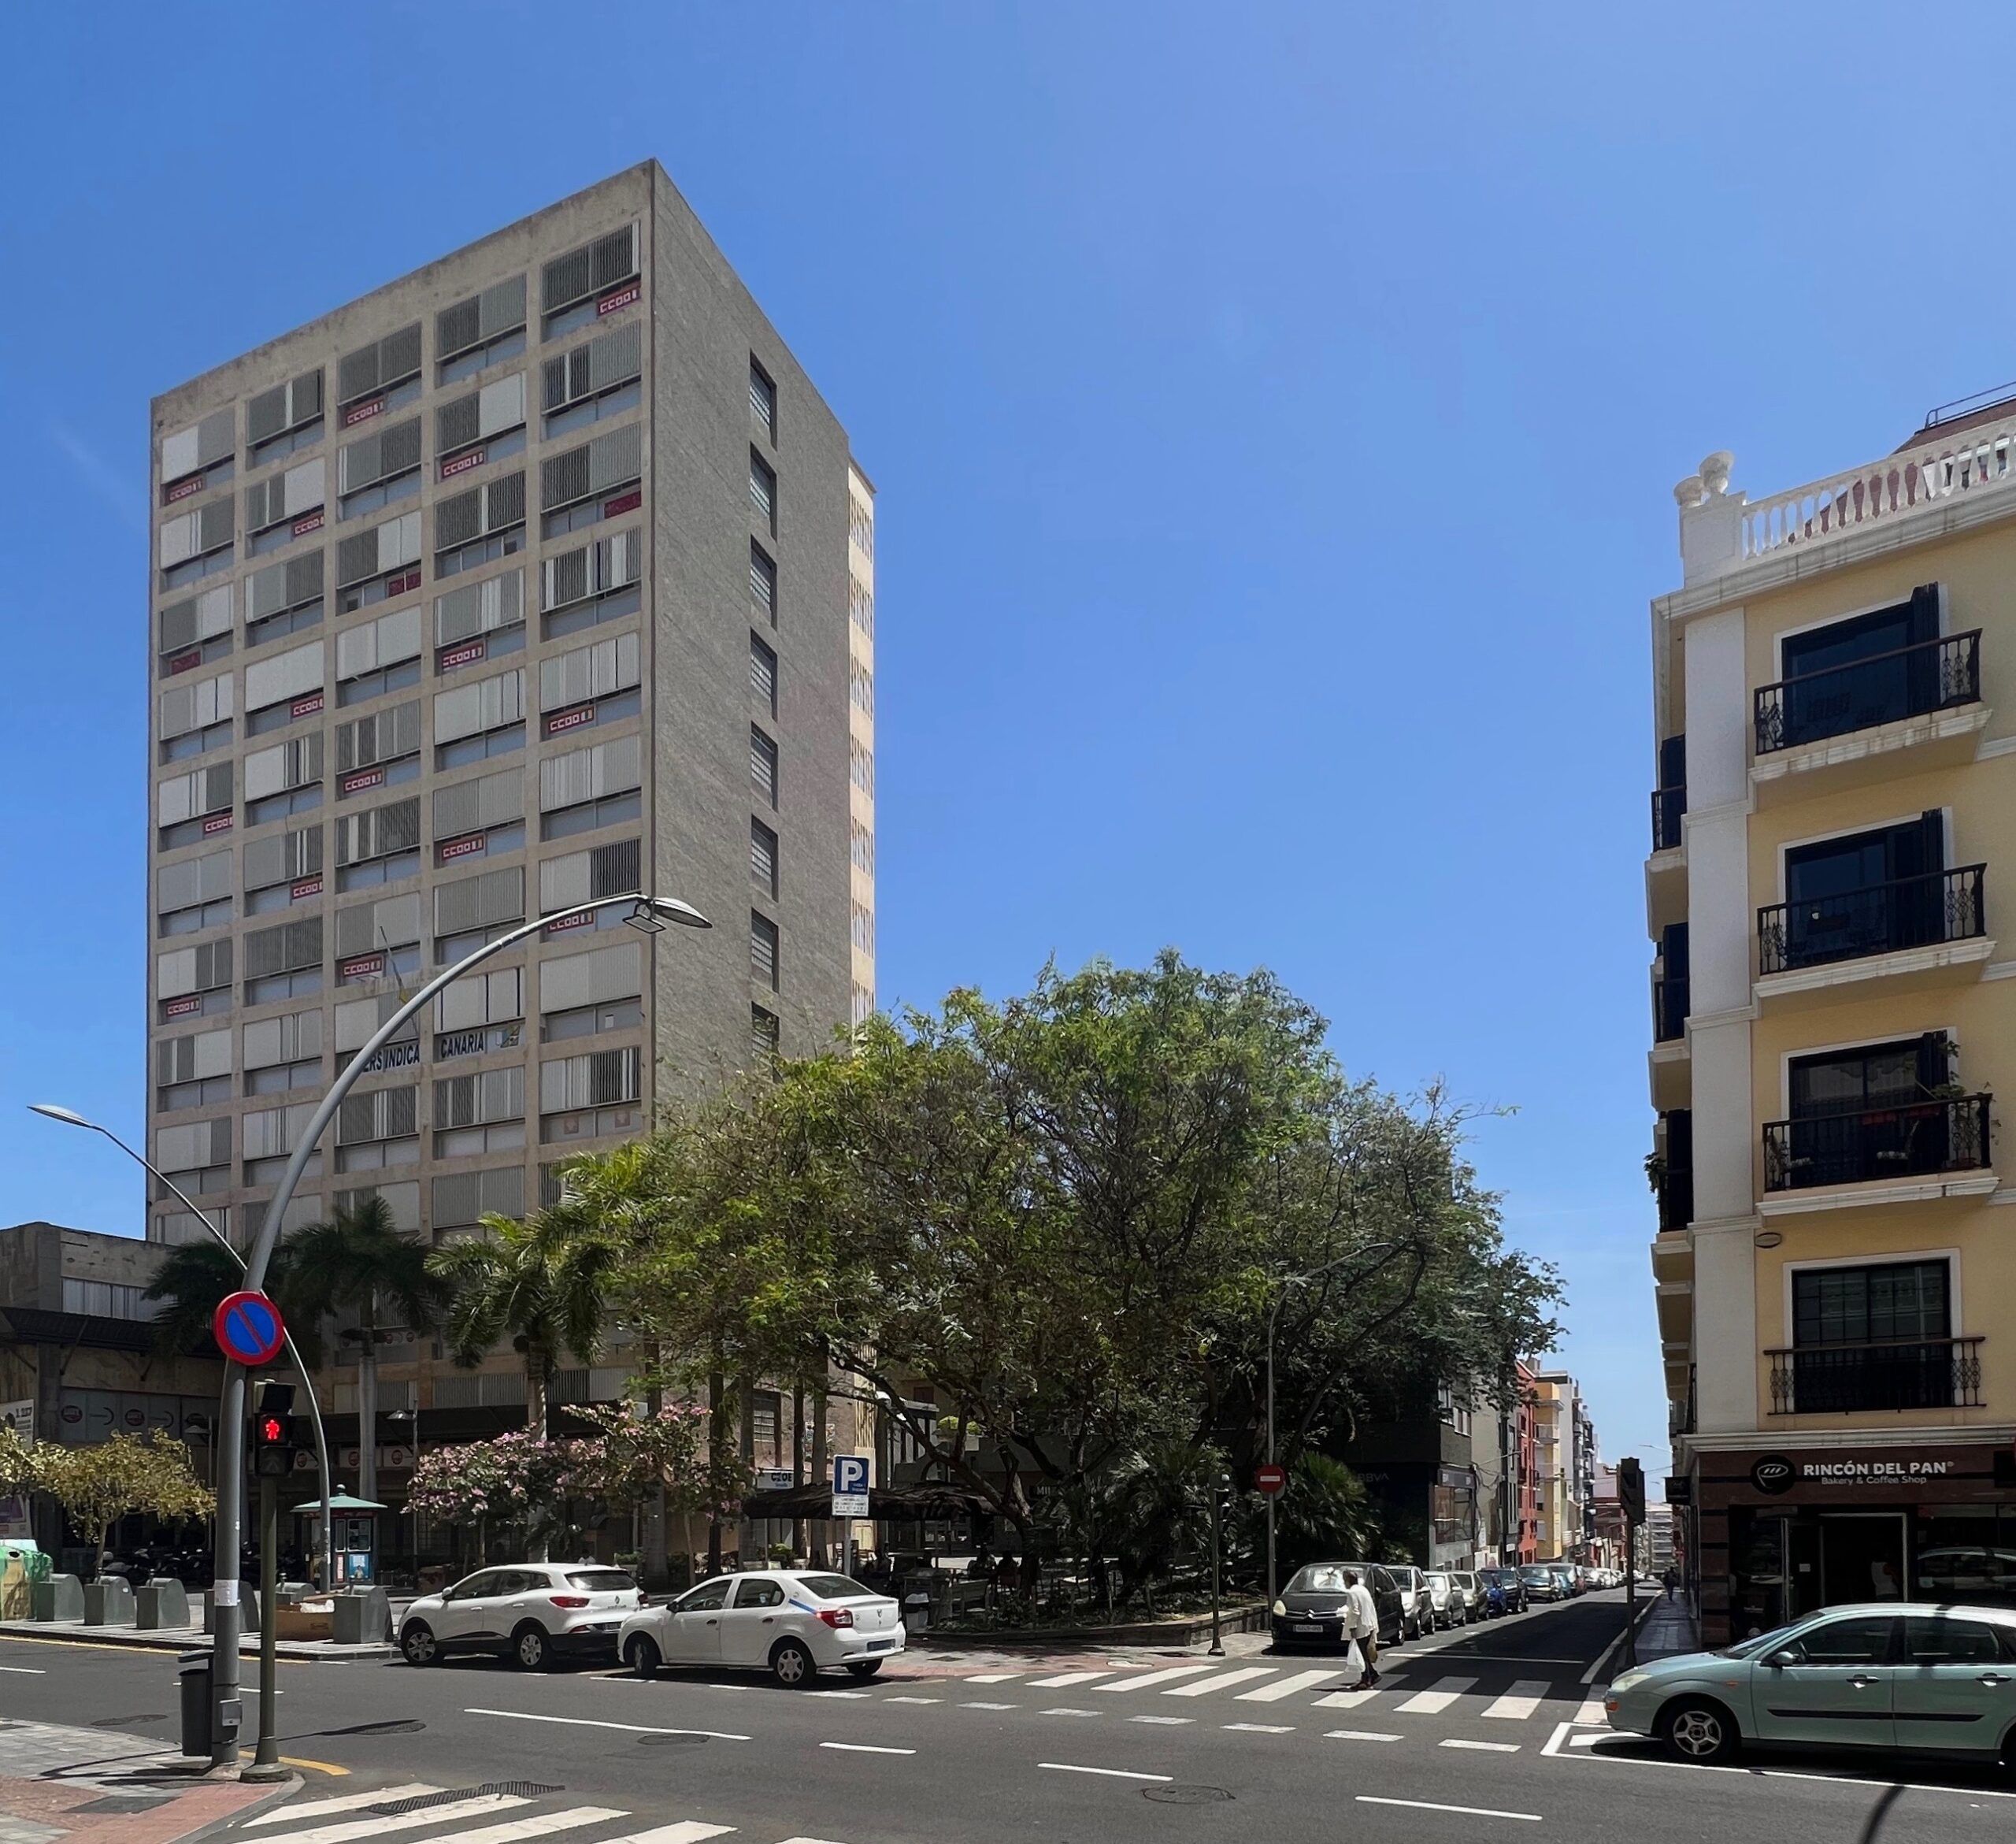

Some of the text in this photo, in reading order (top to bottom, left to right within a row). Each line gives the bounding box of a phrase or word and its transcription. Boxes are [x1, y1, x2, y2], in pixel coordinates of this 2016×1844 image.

[441, 1032, 484, 1058] CANARIA
[841, 1460, 863, 1491] P
[1803, 1460, 1869, 1475] RINCÓN
[1873, 1463, 1906, 1475] DEL
[1821, 1477, 1853, 1486] Bakery
[1901, 1475, 1927, 1485] Shop
